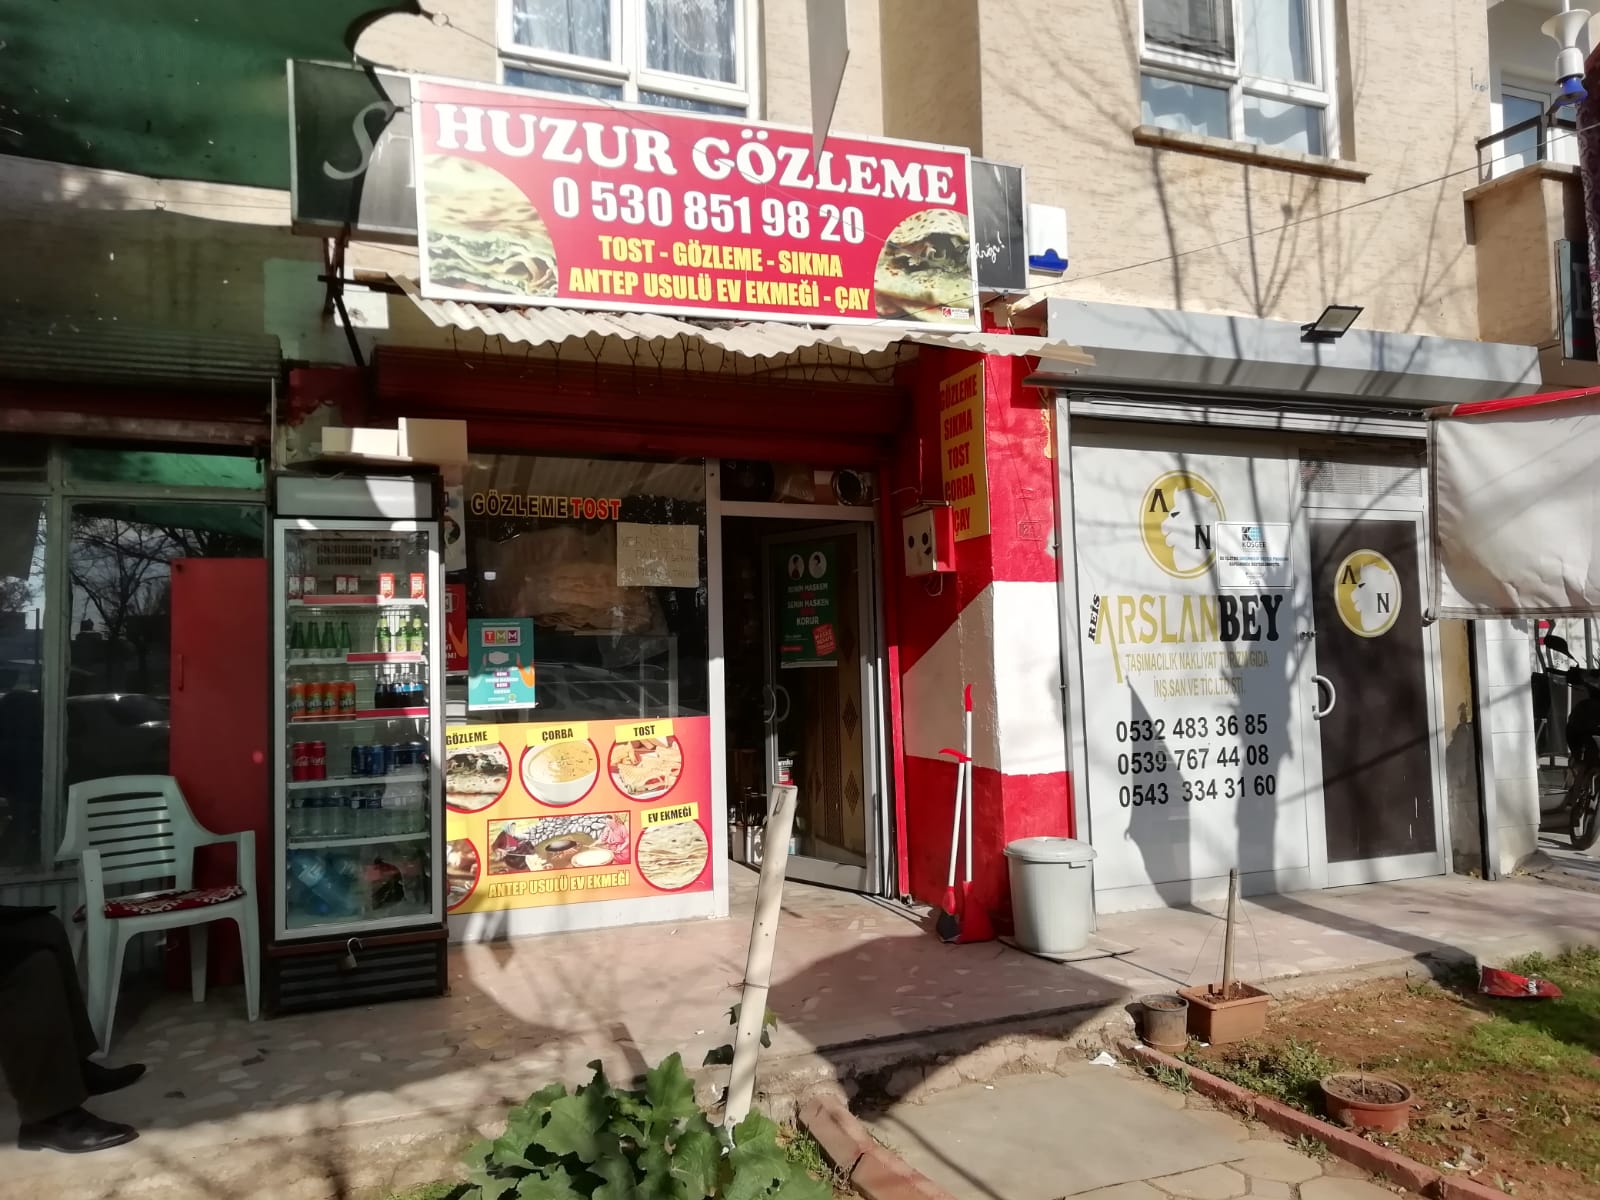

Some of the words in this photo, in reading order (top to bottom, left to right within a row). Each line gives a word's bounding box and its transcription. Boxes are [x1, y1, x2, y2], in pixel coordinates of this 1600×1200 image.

[434, 103, 678, 176] HUZUR
[691, 128, 957, 206] GÖZLEME
[553, 177, 580, 218] 0
[591, 181, 673, 227] 530
[684, 191, 751, 234] 851
[762, 198, 810, 240] 98
[819, 204, 865, 245] 20
[598, 235, 655, 264] TOST
[673, 239, 763, 272] GÖZLEME
[779, 250, 843, 278] SIKMA
[569, 267, 639, 297] ANTEP
[644, 272, 712, 302] USULÜ
[717, 280, 741, 304] EV
[745, 281, 820, 308] EKMEĞİ
[835, 286, 870, 313] ÇAY
[940, 373, 977, 411] GÖZLEME
[943, 409, 973, 440] SIKMA
[947, 442, 970, 471] TOST
[470, 489, 568, 518] GÖZLEME
[570, 497, 621, 520] TOST
[954, 507, 970, 536] ÇAY
[1194, 525, 1211, 550] N
[1376, 593, 1390, 613] N
[1126, 653, 1177, 675] TAŞIMACILIK
[1179, 648, 1217, 670] NAKLİYAT
[1250, 650, 1270, 667] GIDA
[446, 731, 488, 746] GÖZLEME
[542, 727, 574, 742] ÇORBA
[633, 725, 656, 737] TOST
[1116, 719, 1166, 742] 0532
[1172, 717, 1208, 738] 483
[1215, 715, 1239, 736] 36
[1245, 714, 1268, 735] 85
[1118, 751, 1167, 775] 0539
[1174, 748, 1209, 770] 767
[1216, 746, 1240, 767] 44
[1246, 744, 1269, 766] 08
[1119, 782, 1169, 807] 0543
[1182, 779, 1218, 802] 334
[1224, 776, 1246, 799] 31
[1254, 775, 1276, 796] 60
[648, 812, 659, 824] EV
[660, 806, 692, 822] EKMEĞİ
[487, 881, 527, 898] ANTEP
[530, 876, 568, 894] USULÜ
[570, 877, 585, 891] EV
[586, 870, 630, 889] EKMEĞİ
